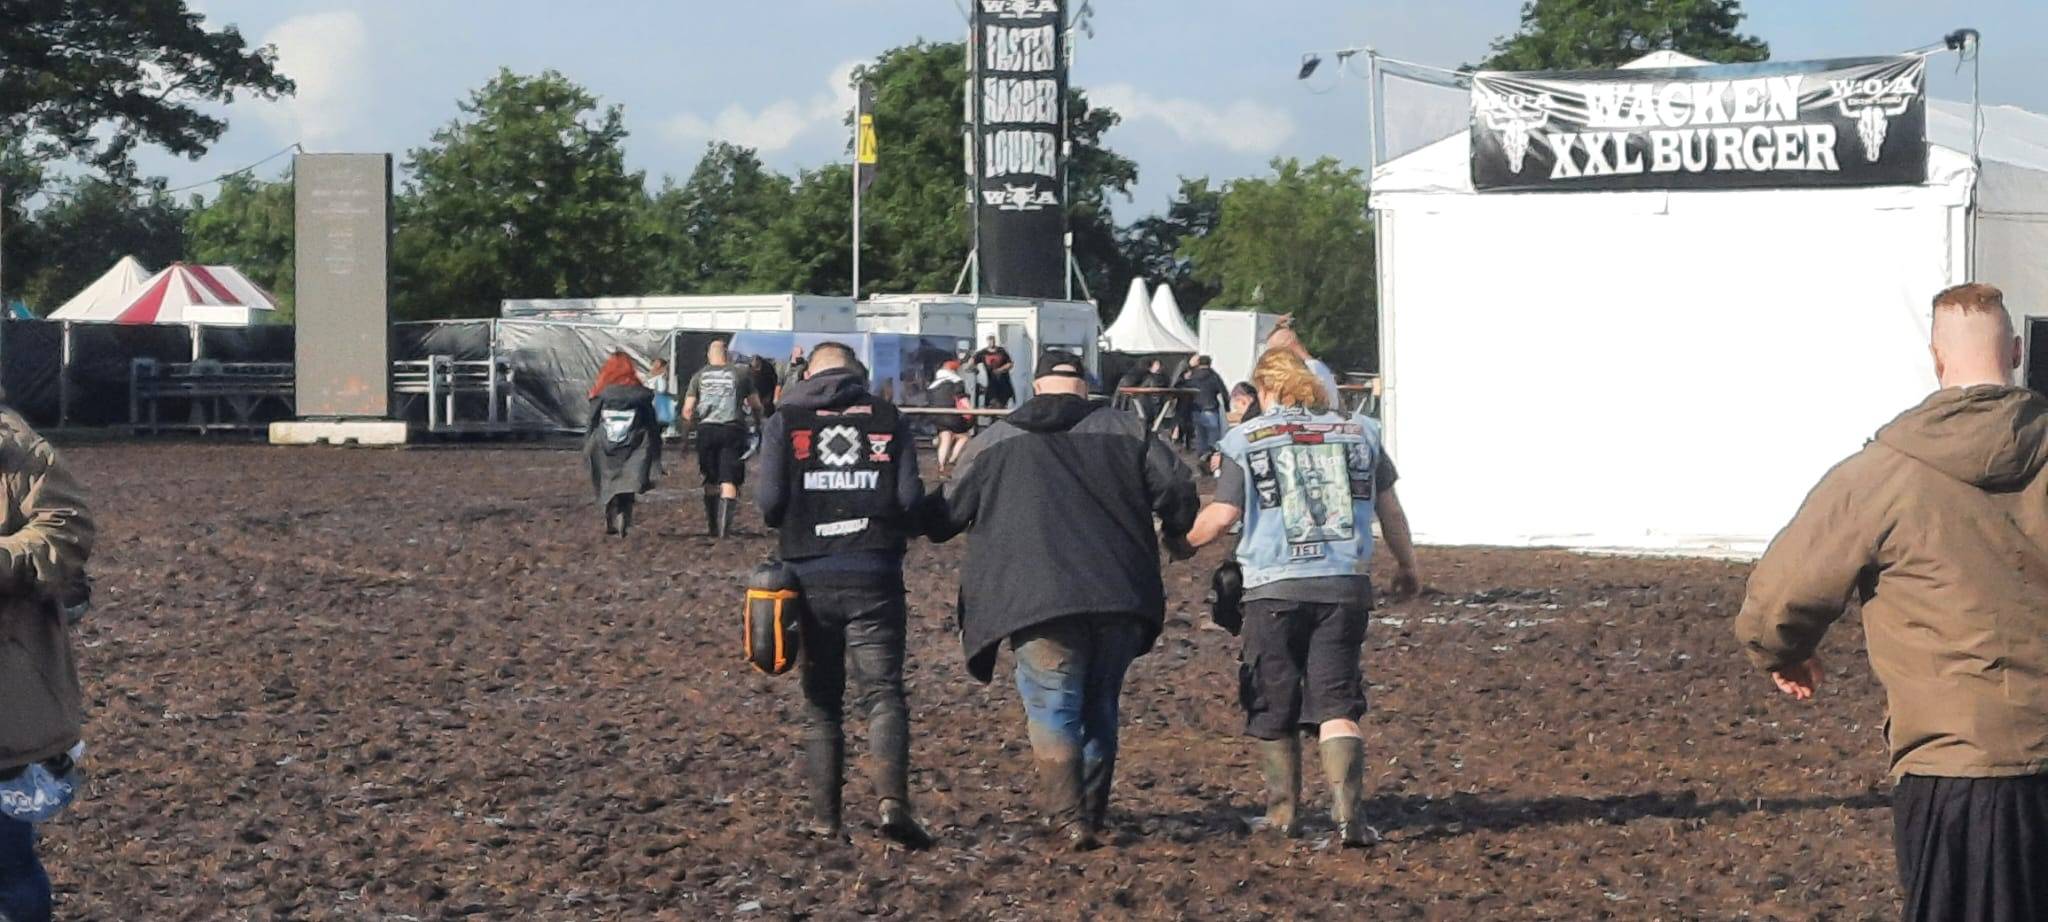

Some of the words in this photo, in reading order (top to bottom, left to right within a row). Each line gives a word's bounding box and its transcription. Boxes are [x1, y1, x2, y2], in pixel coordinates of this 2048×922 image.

[986, 25, 1055, 71] FASTER
[984, 77, 1058, 125] HARDER
[1583, 75, 1803, 127] WACKEN
[985, 130, 1056, 178] LOUDER
[1549, 132, 1644, 179] XXL
[1649, 124, 1840, 173] BURGER
[804, 470, 880, 490] METALITY
